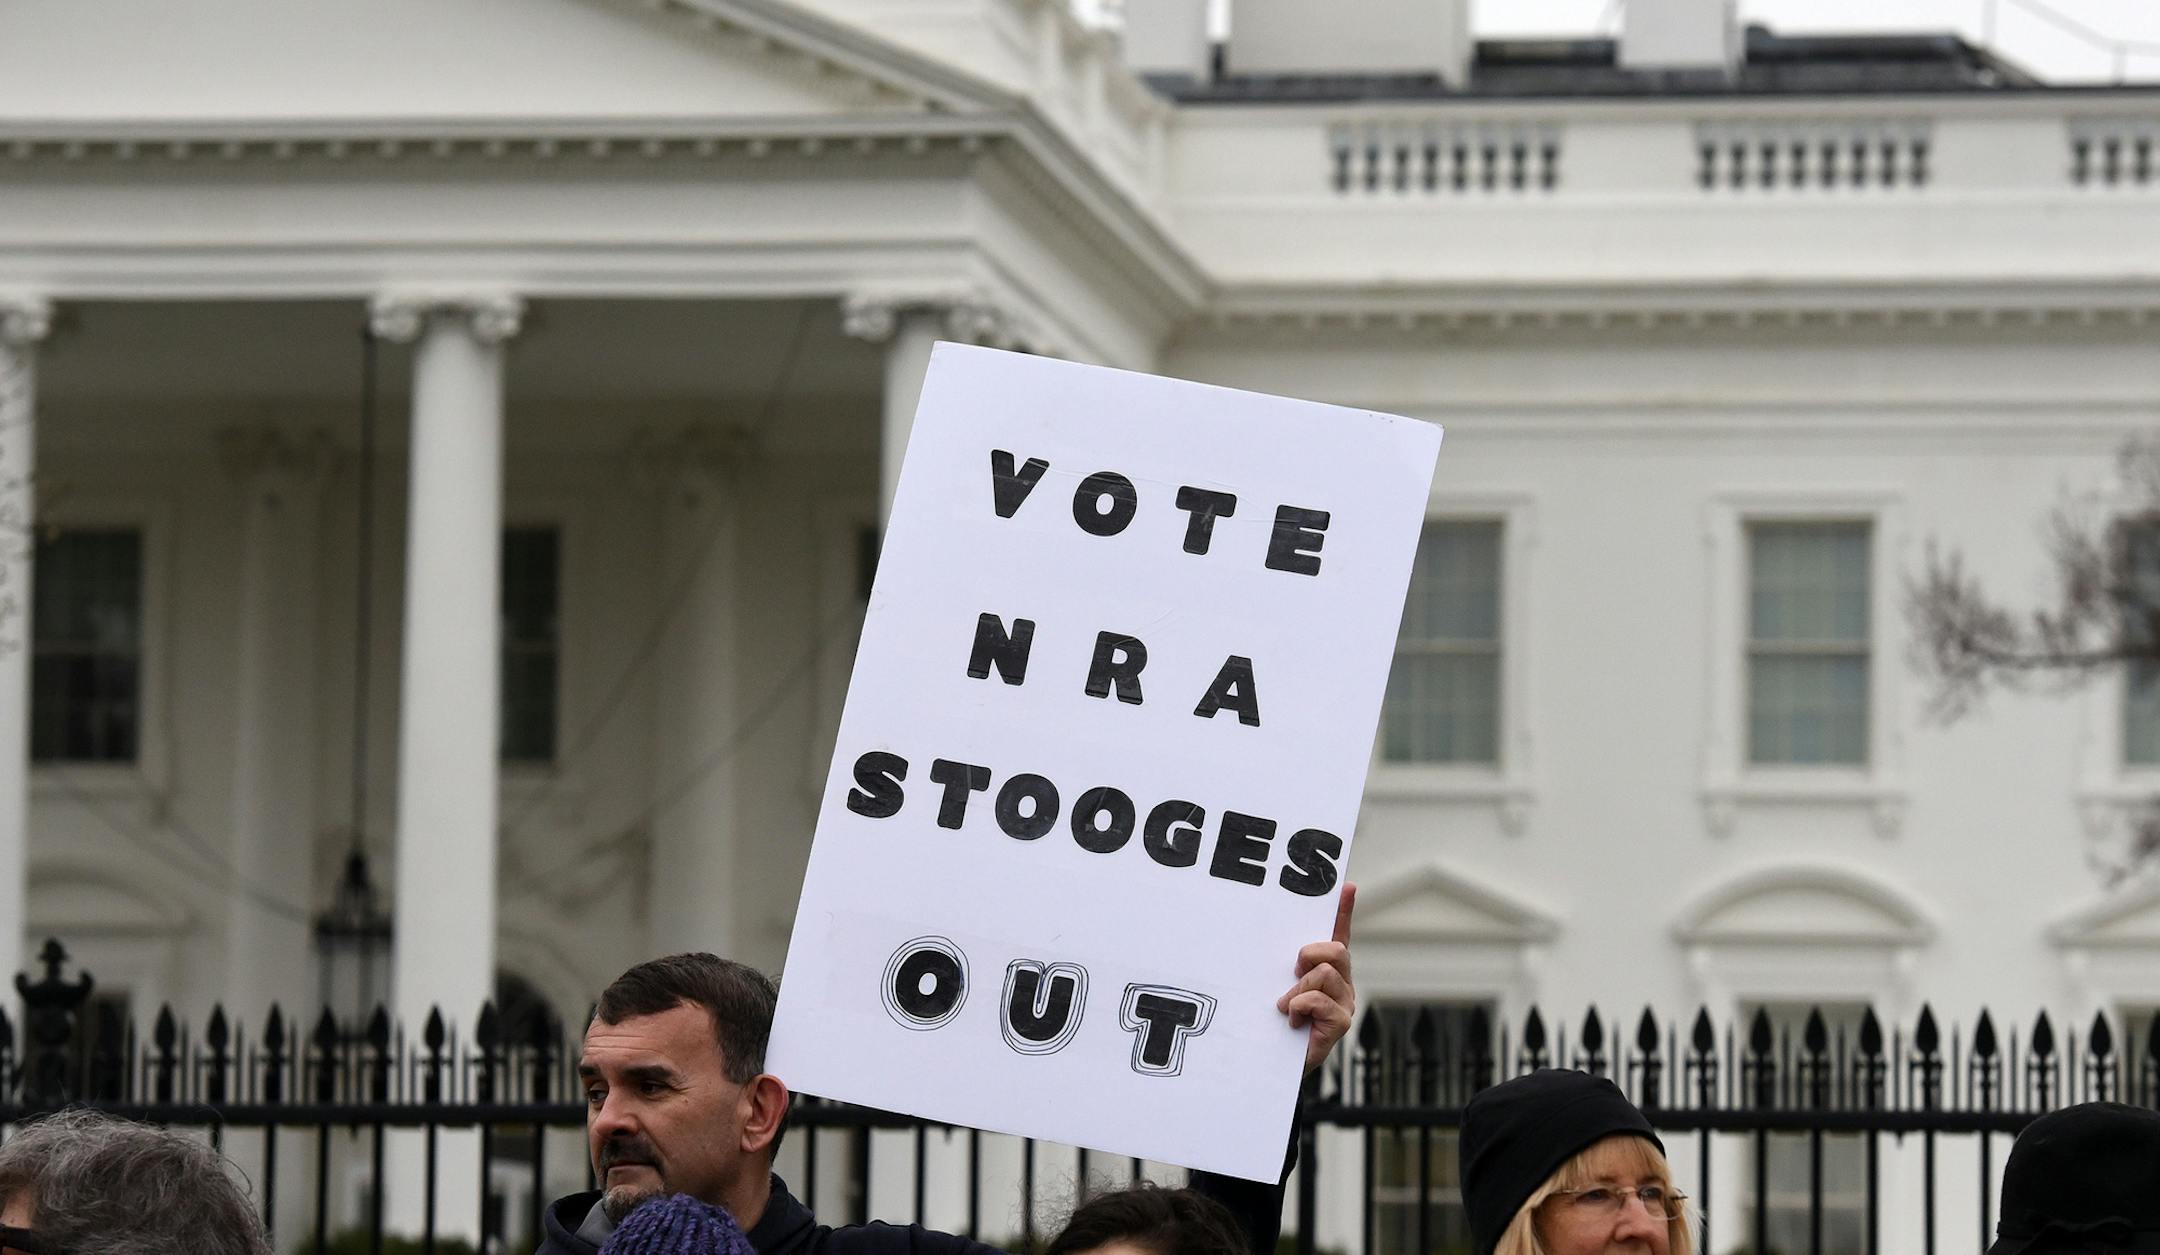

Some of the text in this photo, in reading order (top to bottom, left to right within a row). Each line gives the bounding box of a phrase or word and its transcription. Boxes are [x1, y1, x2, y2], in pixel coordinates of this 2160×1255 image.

[990, 449, 1331, 577] VOTE
[966, 612, 1261, 728] NRA
[846, 751, 1343, 897] STOOGES
[894, 949, 1199, 1067] OUT
